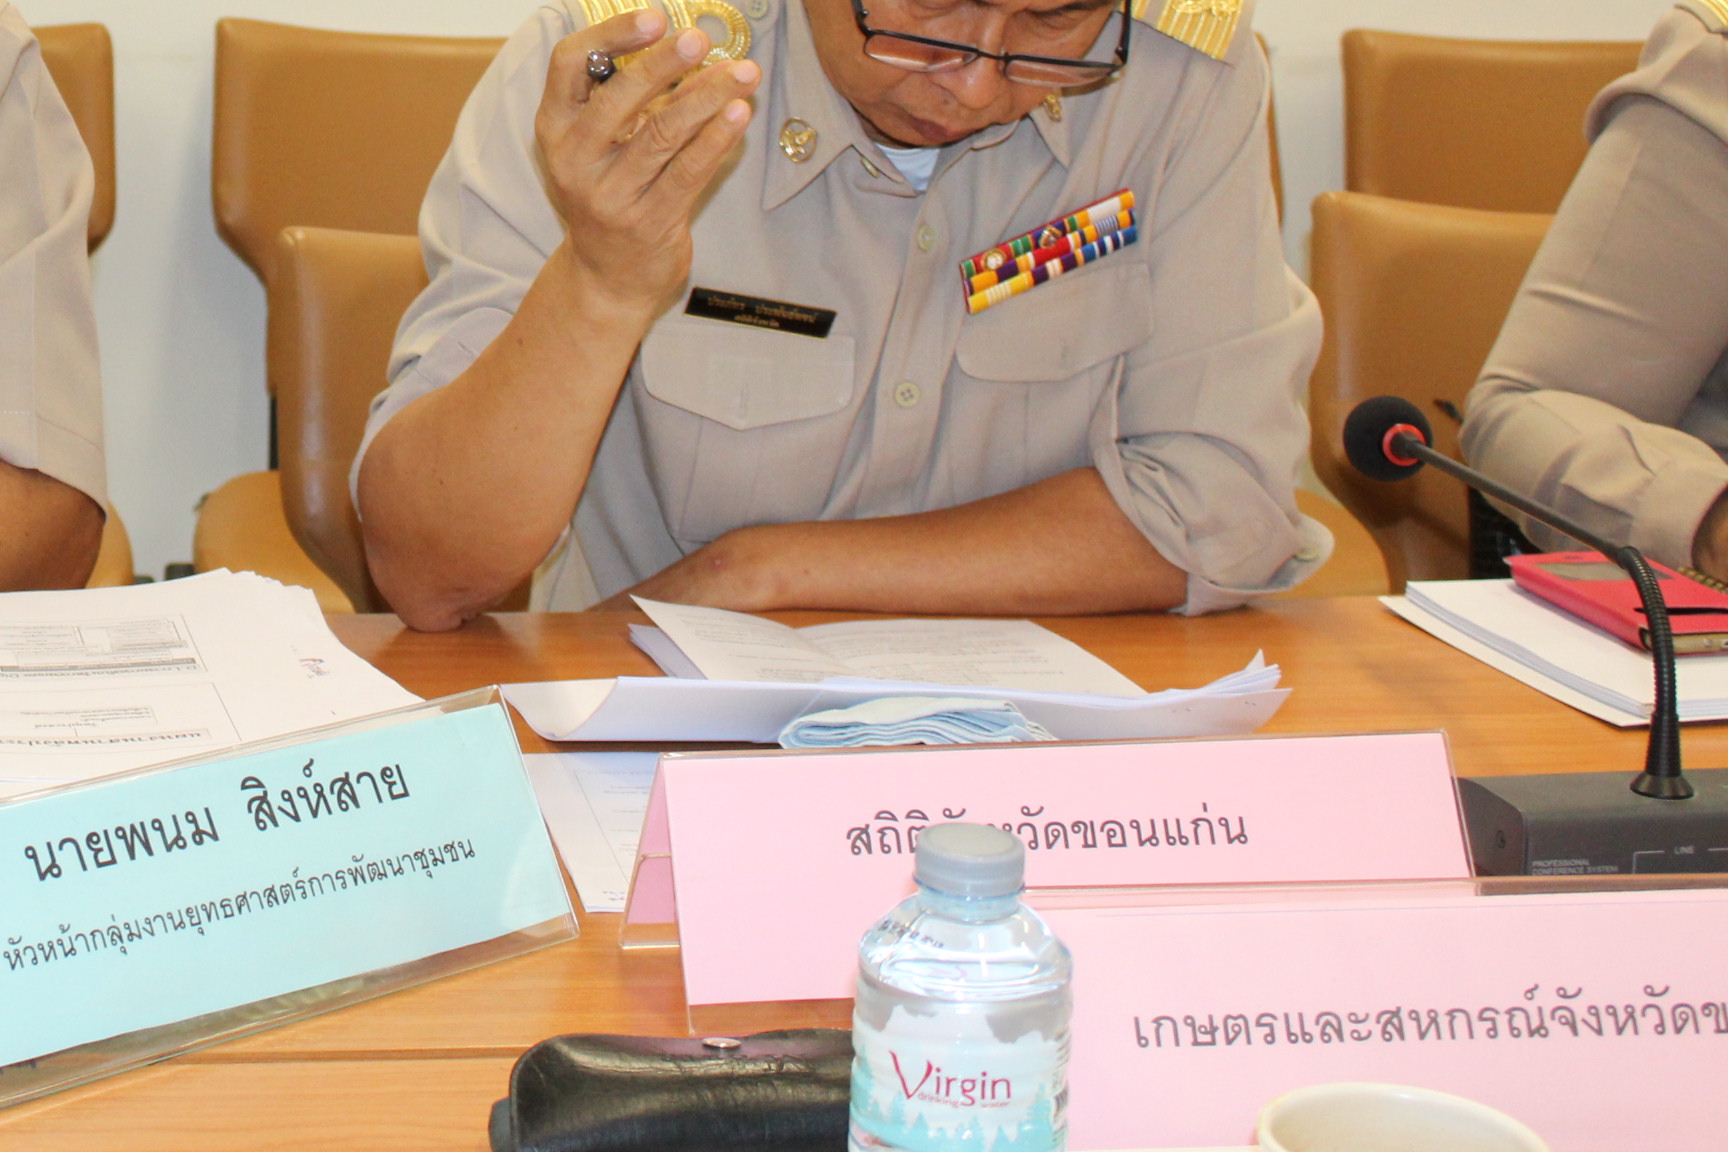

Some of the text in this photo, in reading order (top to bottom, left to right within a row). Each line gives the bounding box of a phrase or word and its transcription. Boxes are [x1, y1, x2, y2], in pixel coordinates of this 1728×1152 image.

[23, 756, 412, 884] นายพนม สิงห์สาย
[1674, 846, 1694, 855] LINE
[3, 834, 477, 973] หัวหน้ากลุ่มงานยุทธศาสตร์การพัฒนาชุมชน
[888, 1050, 1012, 1107] Virgin
